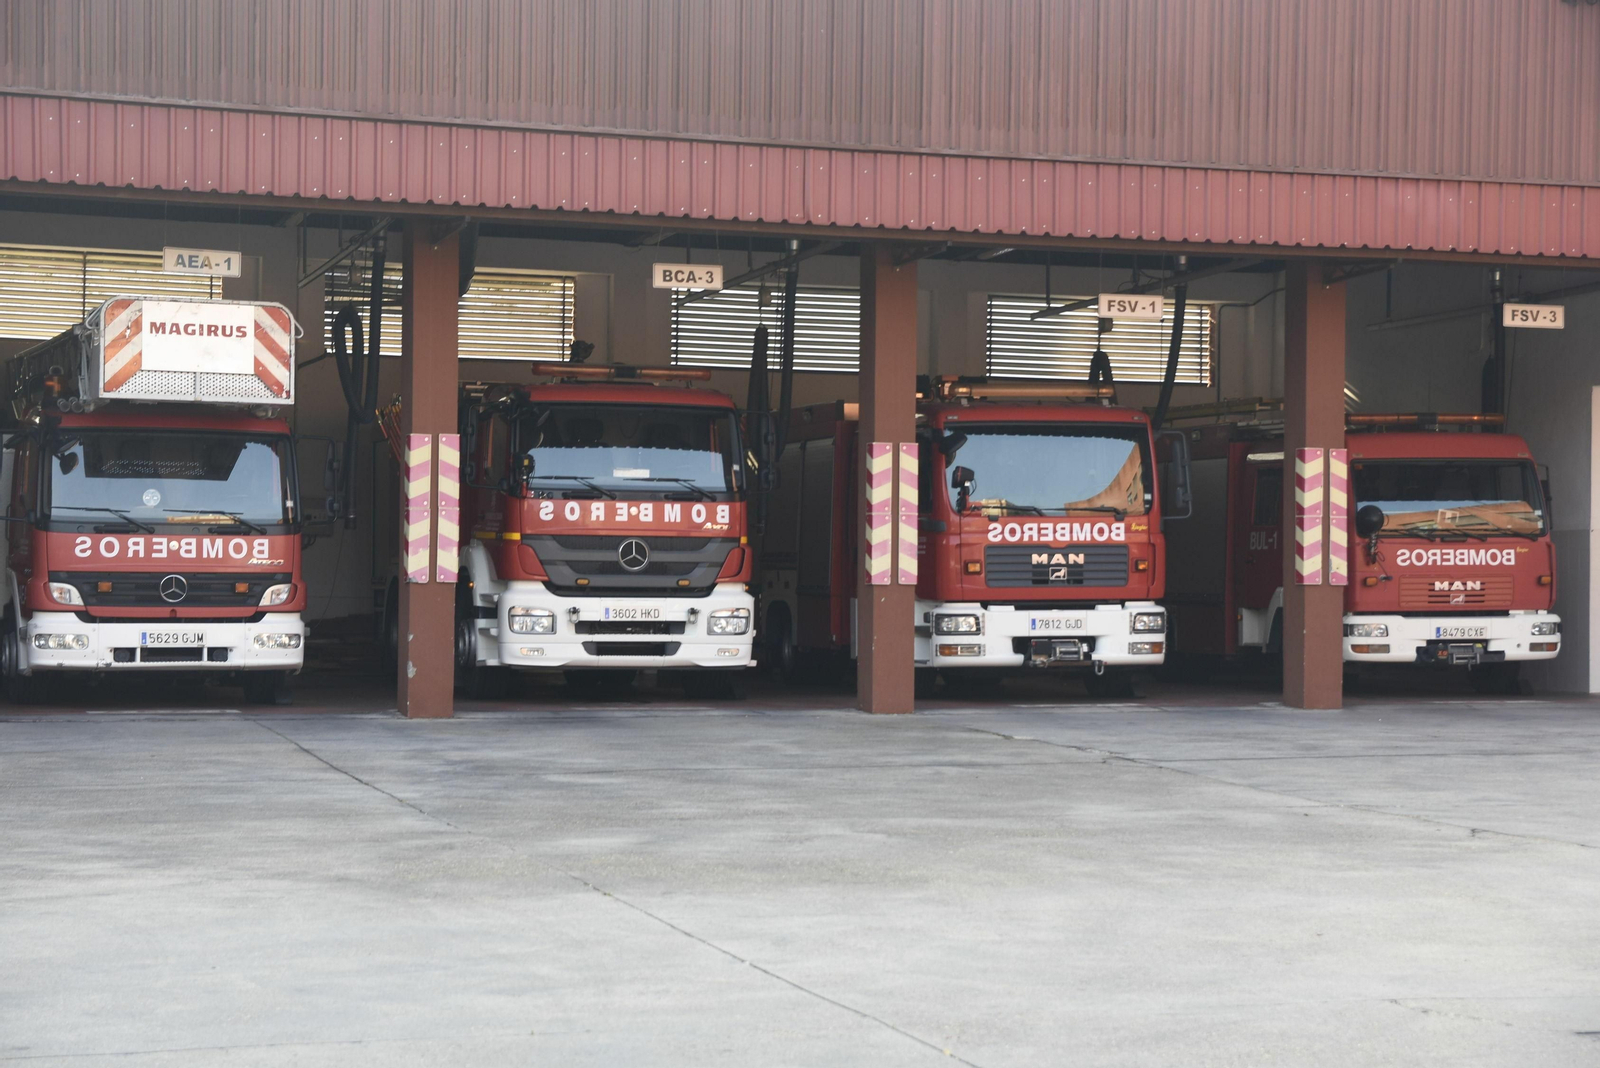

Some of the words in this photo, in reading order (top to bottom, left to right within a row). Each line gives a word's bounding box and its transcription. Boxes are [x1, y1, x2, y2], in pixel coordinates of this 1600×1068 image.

[662, 269, 714, 284] BCA-3
[149, 321, 248, 338] MAGIRUS
[1250, 531, 1278, 550] BUL-1
[1031, 553, 1085, 565] MAN
[1434, 580, 1481, 591] MAN
[612, 608, 637, 619] 3602
[640, 608, 660, 619] HKD
[1038, 619, 1062, 629] 7812
[1065, 619, 1083, 629] GJD
[149, 632, 179, 644] 5629
[182, 632, 204, 644] GJM
[1442, 627, 1466, 637] 8479
[1467, 627, 1485, 637] CXE
